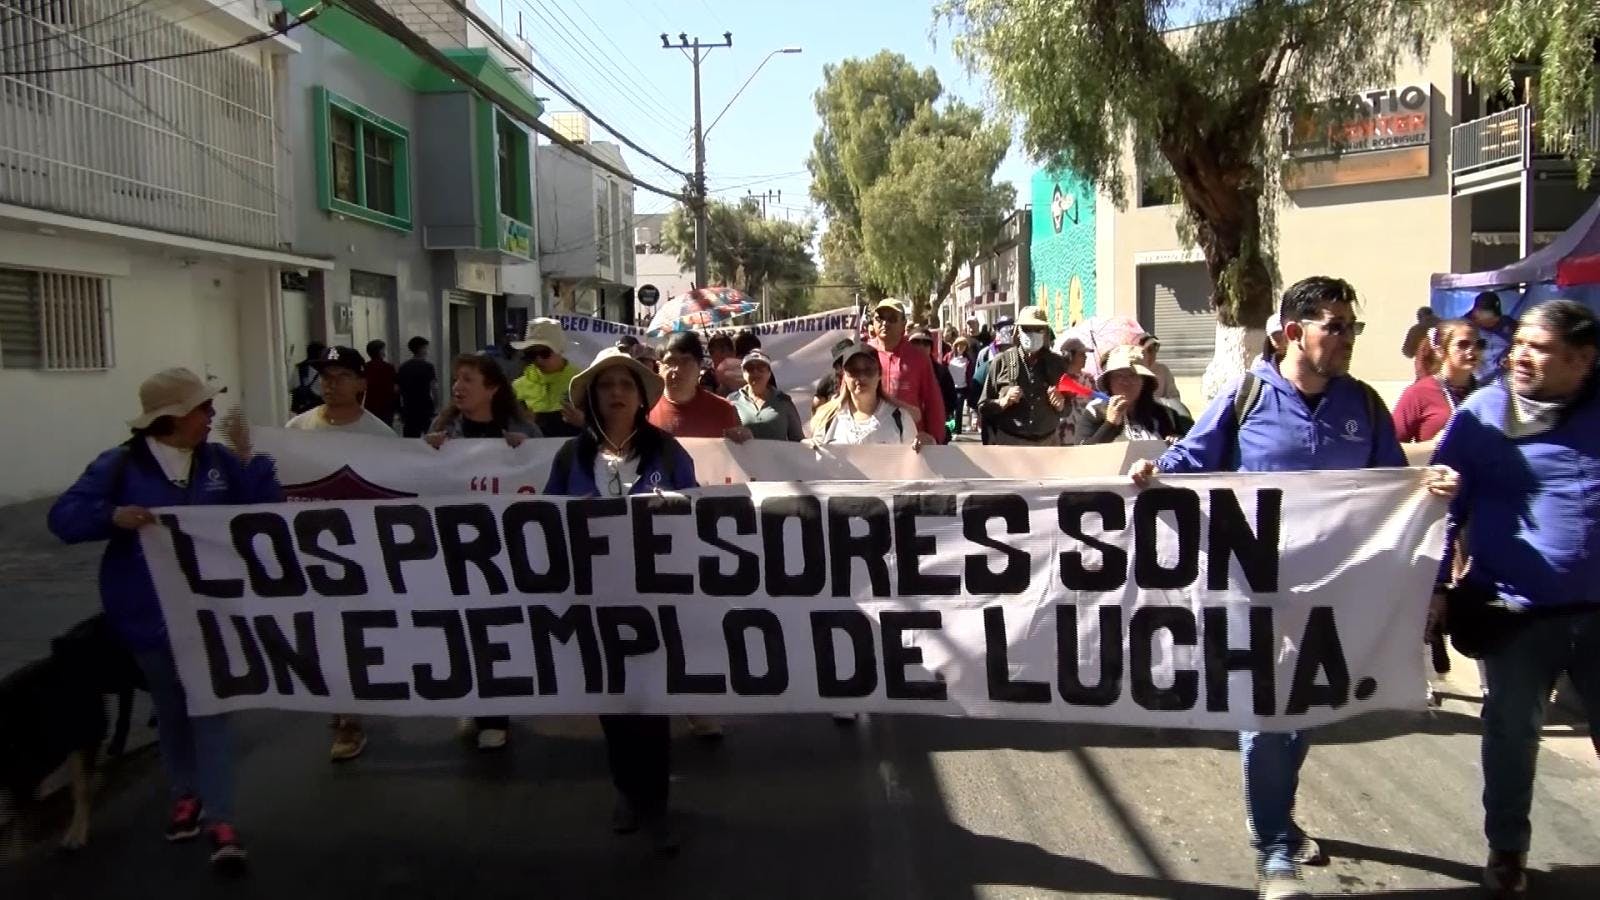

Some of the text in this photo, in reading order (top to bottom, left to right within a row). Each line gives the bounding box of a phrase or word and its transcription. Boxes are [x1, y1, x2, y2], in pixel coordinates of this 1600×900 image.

[1372, 133, 1426, 147] RODRIGUEZ
[549, 314, 589, 331] CEO
[783, 314, 858, 333] MARTÍNEZ
[159, 488, 1282, 597] LOS PROFESORES SON
[197, 604, 1378, 716] UN EJEMPLO DE LUCHA.
